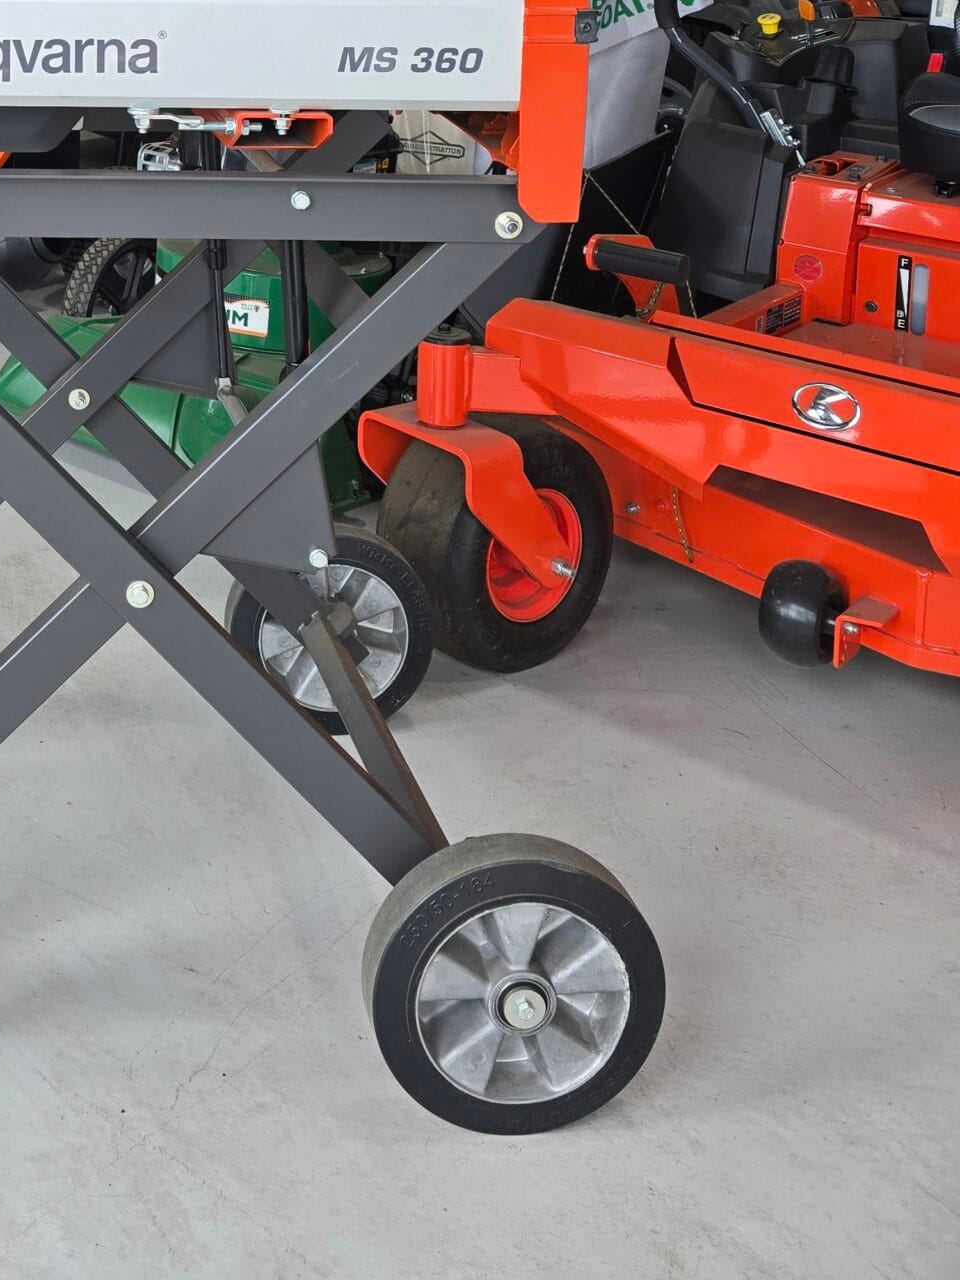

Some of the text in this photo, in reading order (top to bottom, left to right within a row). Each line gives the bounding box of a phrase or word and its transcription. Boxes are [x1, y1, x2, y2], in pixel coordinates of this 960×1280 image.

[338, 46, 484, 74] MS 360
[901, 258, 909, 267] F
[897, 318, 906, 329] E
